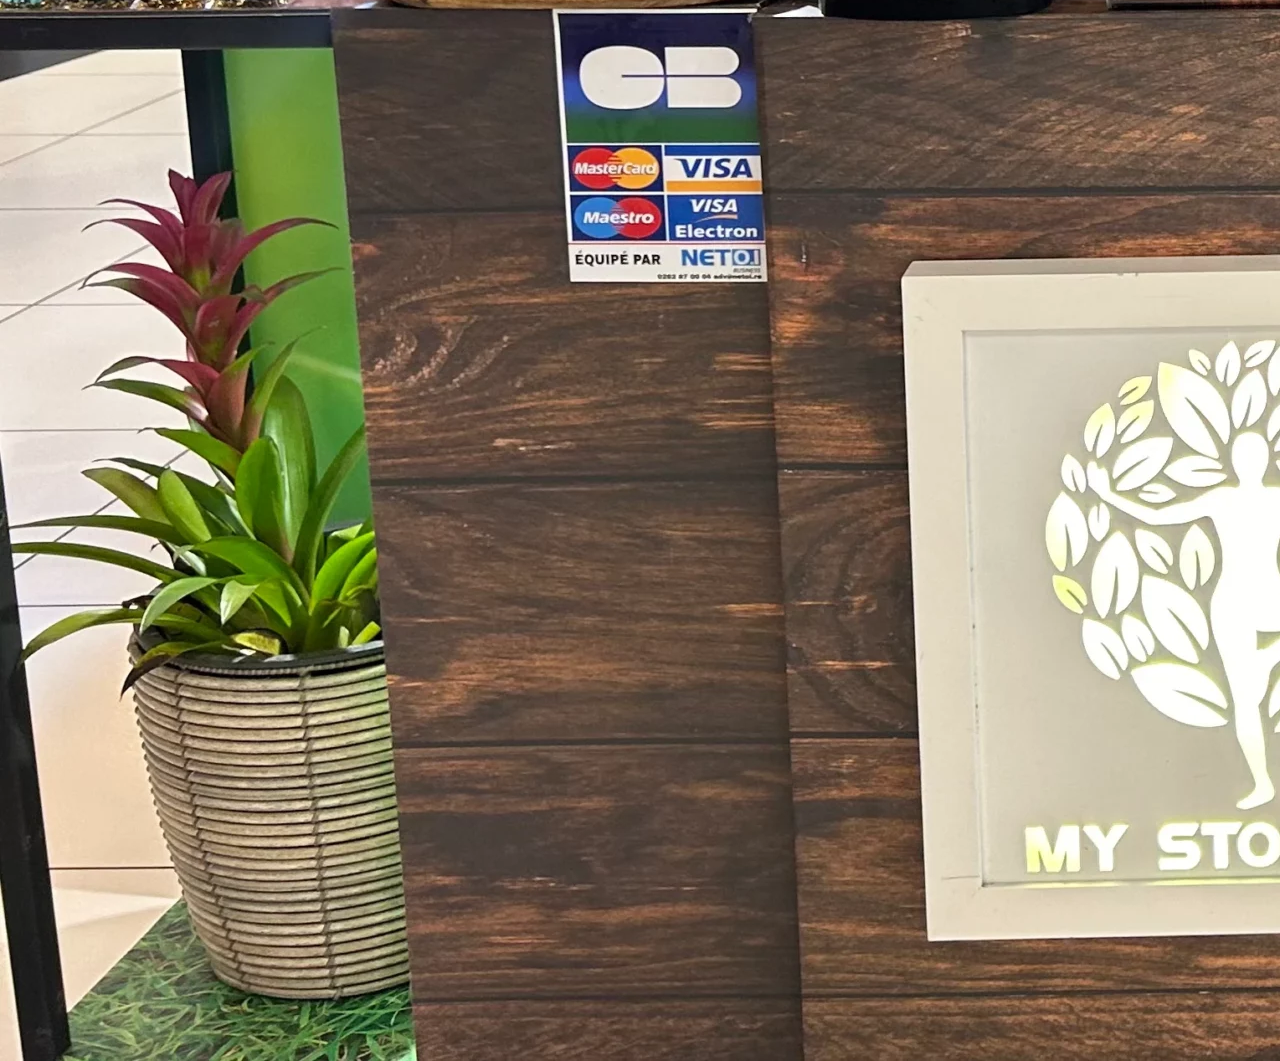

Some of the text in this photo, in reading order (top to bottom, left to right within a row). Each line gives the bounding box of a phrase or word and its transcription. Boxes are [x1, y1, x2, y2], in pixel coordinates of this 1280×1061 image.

[579, 45, 742, 110] CB
[574, 160, 657, 176] MasterCard
[674, 158, 753, 178] VISA
[690, 198, 738, 213] VISA
[583, 211, 655, 224] Maestro
[675, 225, 758, 238] Electron
[575, 250, 662, 266] ÉQUIPÉ PAR
[1025, 824, 1130, 872] MY
